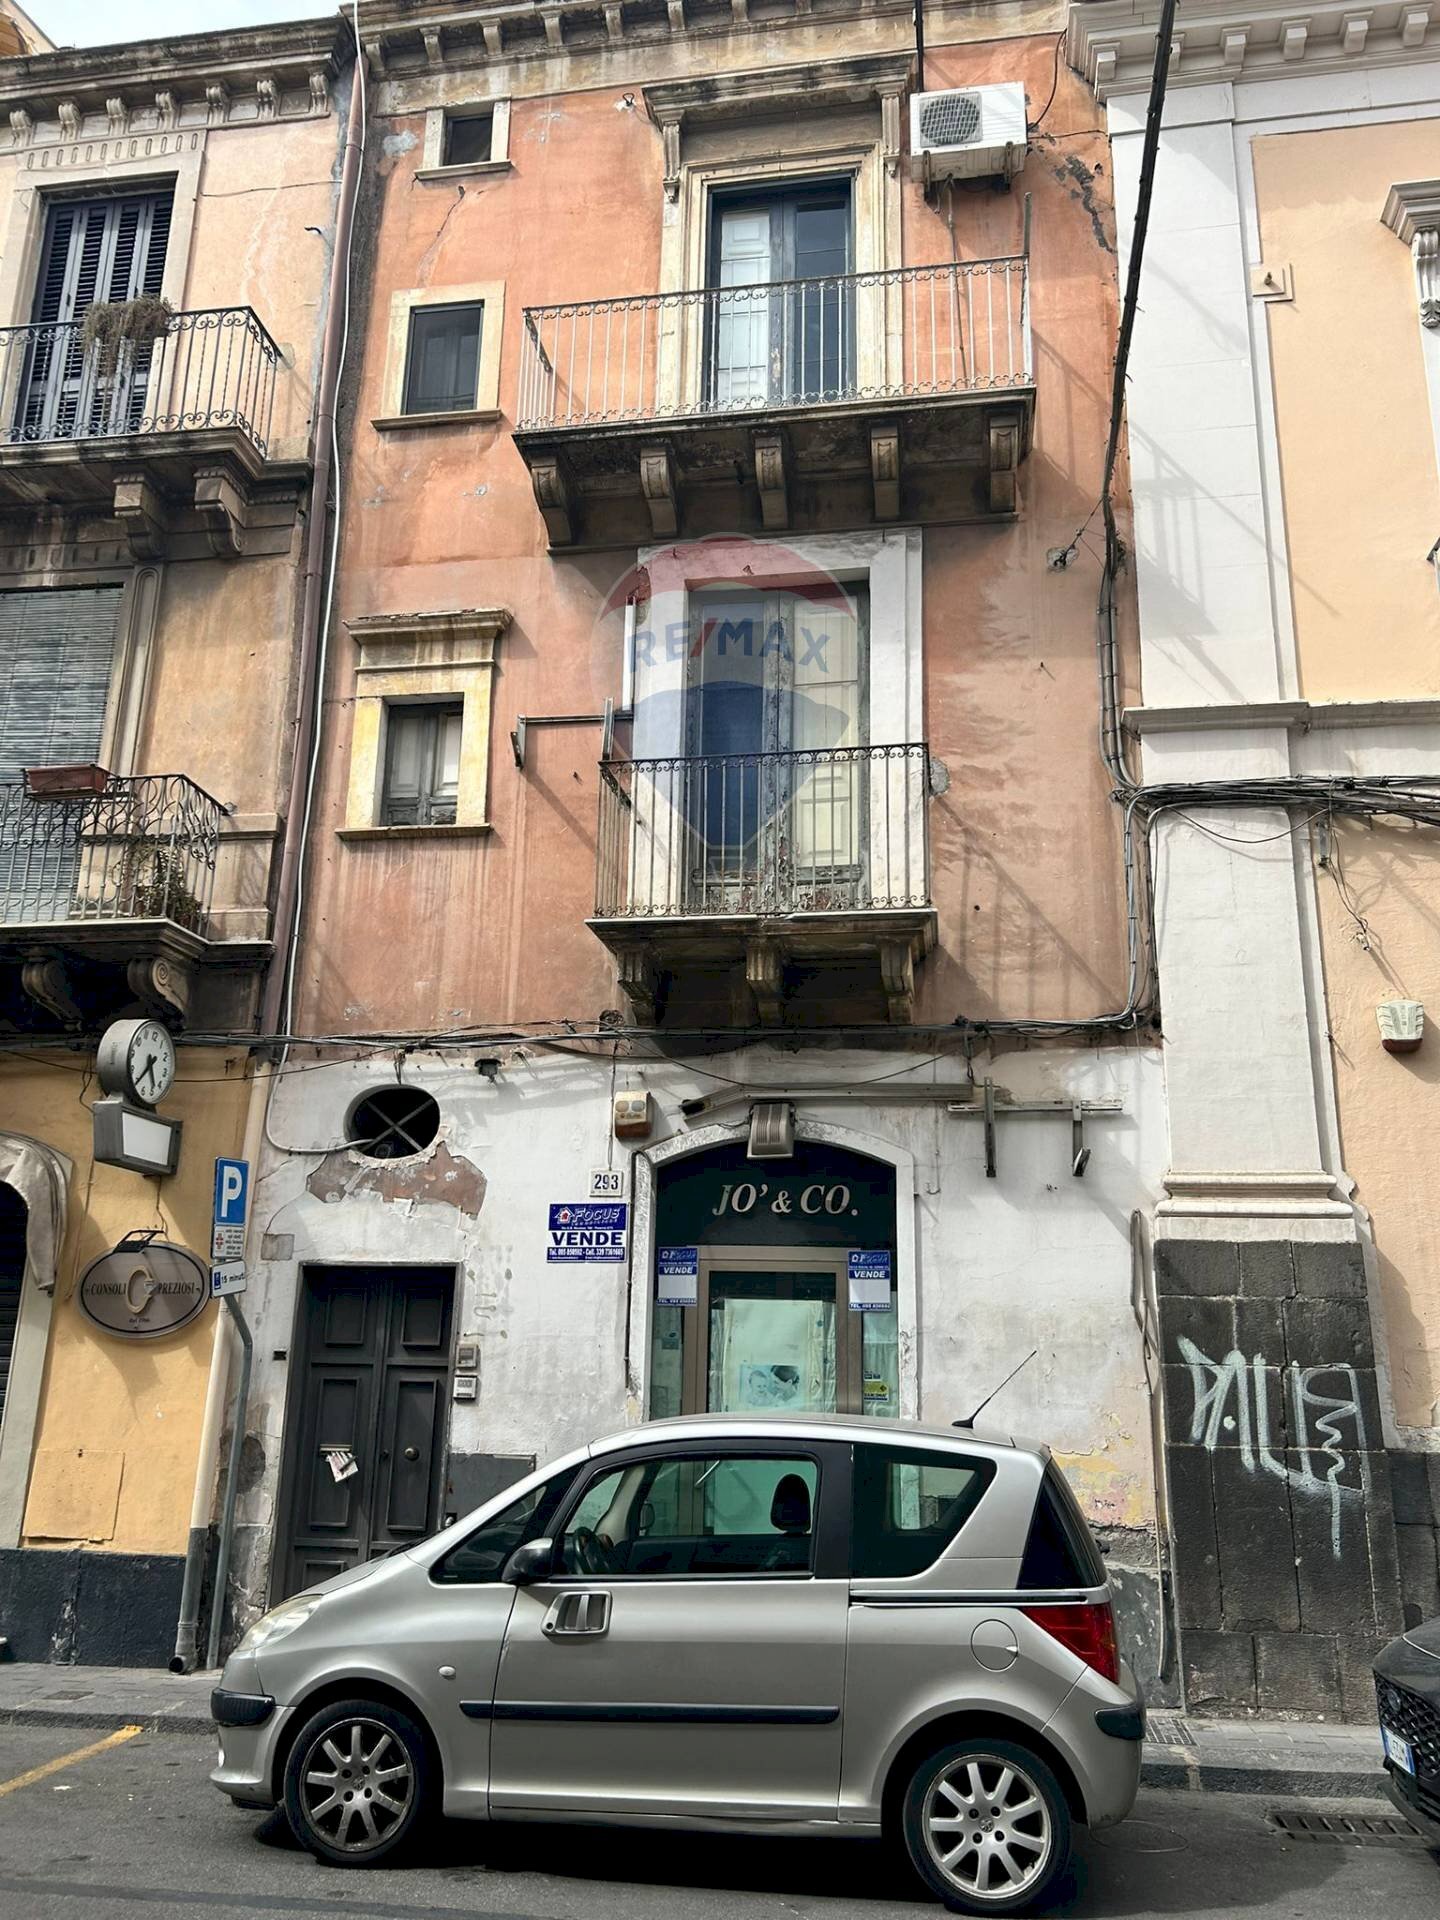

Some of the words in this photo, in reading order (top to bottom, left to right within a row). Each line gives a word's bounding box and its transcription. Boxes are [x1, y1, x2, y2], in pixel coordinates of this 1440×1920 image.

[594, 1174, 619, 1190] 293
[221, 1165, 243, 1217] P
[771, 1190, 793, 1213] &
[800, 1184, 859, 1216] CO.
[551, 1231, 624, 1246] VENDE
[663, 1266, 694, 1274] VENDE
[854, 1270, 886, 1278] VENDE
[91, 1283, 127, 1296] CONSOLI
[157, 1282, 195, 1295] PREZIOSI
